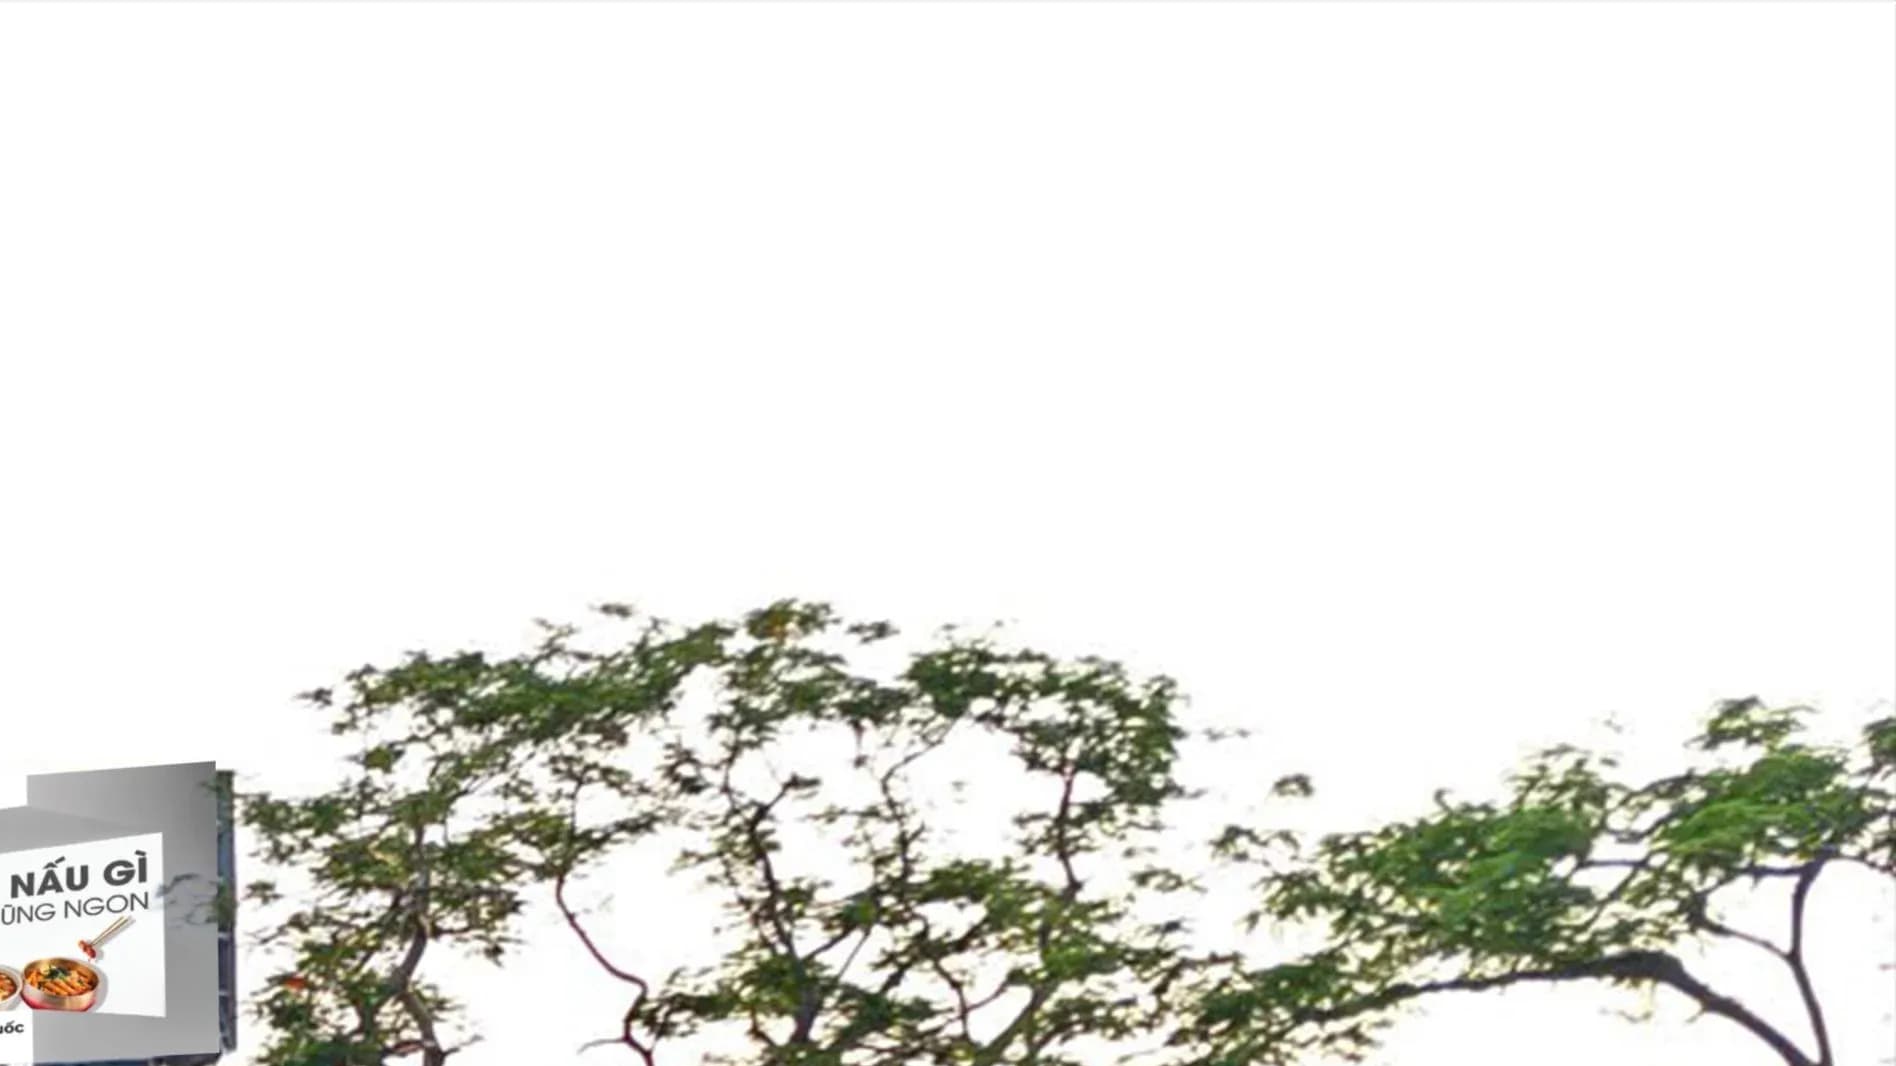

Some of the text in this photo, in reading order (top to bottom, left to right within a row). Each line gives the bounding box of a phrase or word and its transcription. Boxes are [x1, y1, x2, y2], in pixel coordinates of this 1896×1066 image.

[10, 850, 147, 899] NẤU GÌ
[64, 892, 149, 919] NGON
